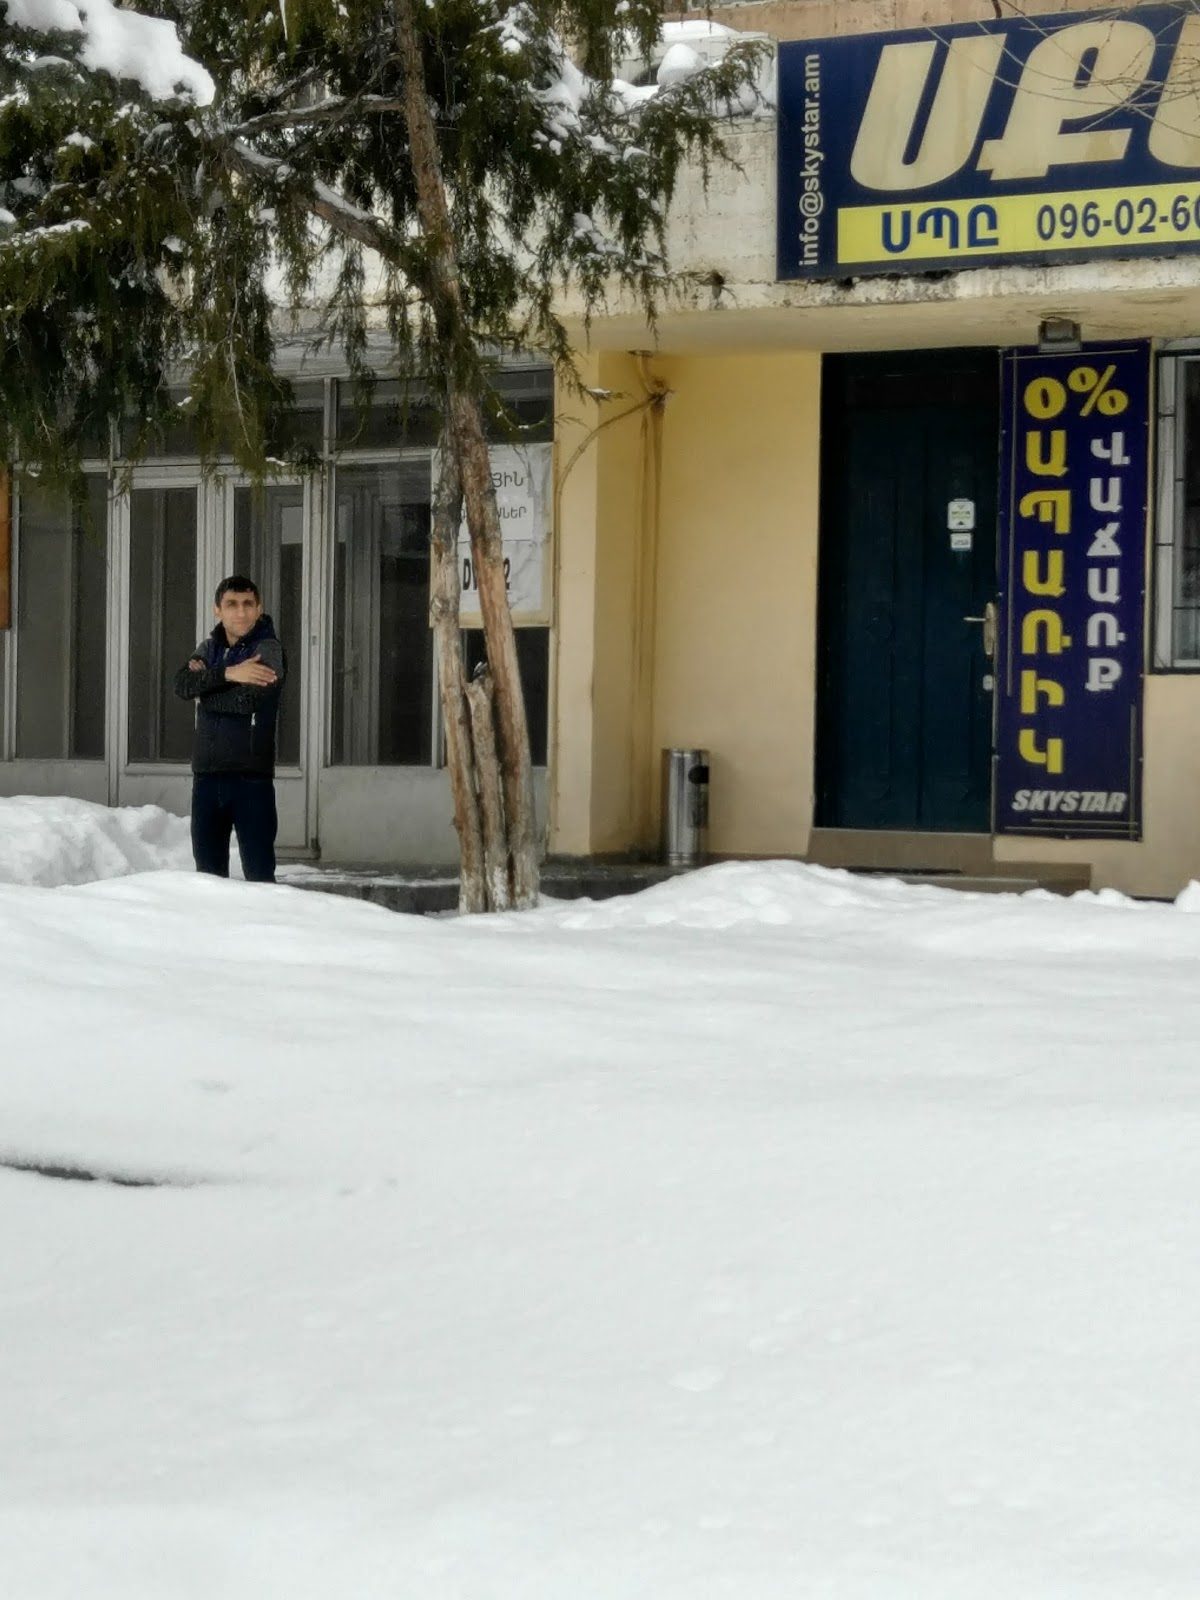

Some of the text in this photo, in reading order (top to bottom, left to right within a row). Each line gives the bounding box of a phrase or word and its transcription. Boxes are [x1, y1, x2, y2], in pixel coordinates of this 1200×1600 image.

[798, 53, 825, 268] info@skystar.am
[881, 193, 1200, 254] ՍՊԸ 096-02-6
[1023, 364, 1129, 420] 0%
[1018, 429, 1073, 775] ԱՊԱՌԻԿ
[1084, 430, 1131, 693] ՎԱՃԱՌՔ
[1011, 788, 1128, 814] SKYSTAR
